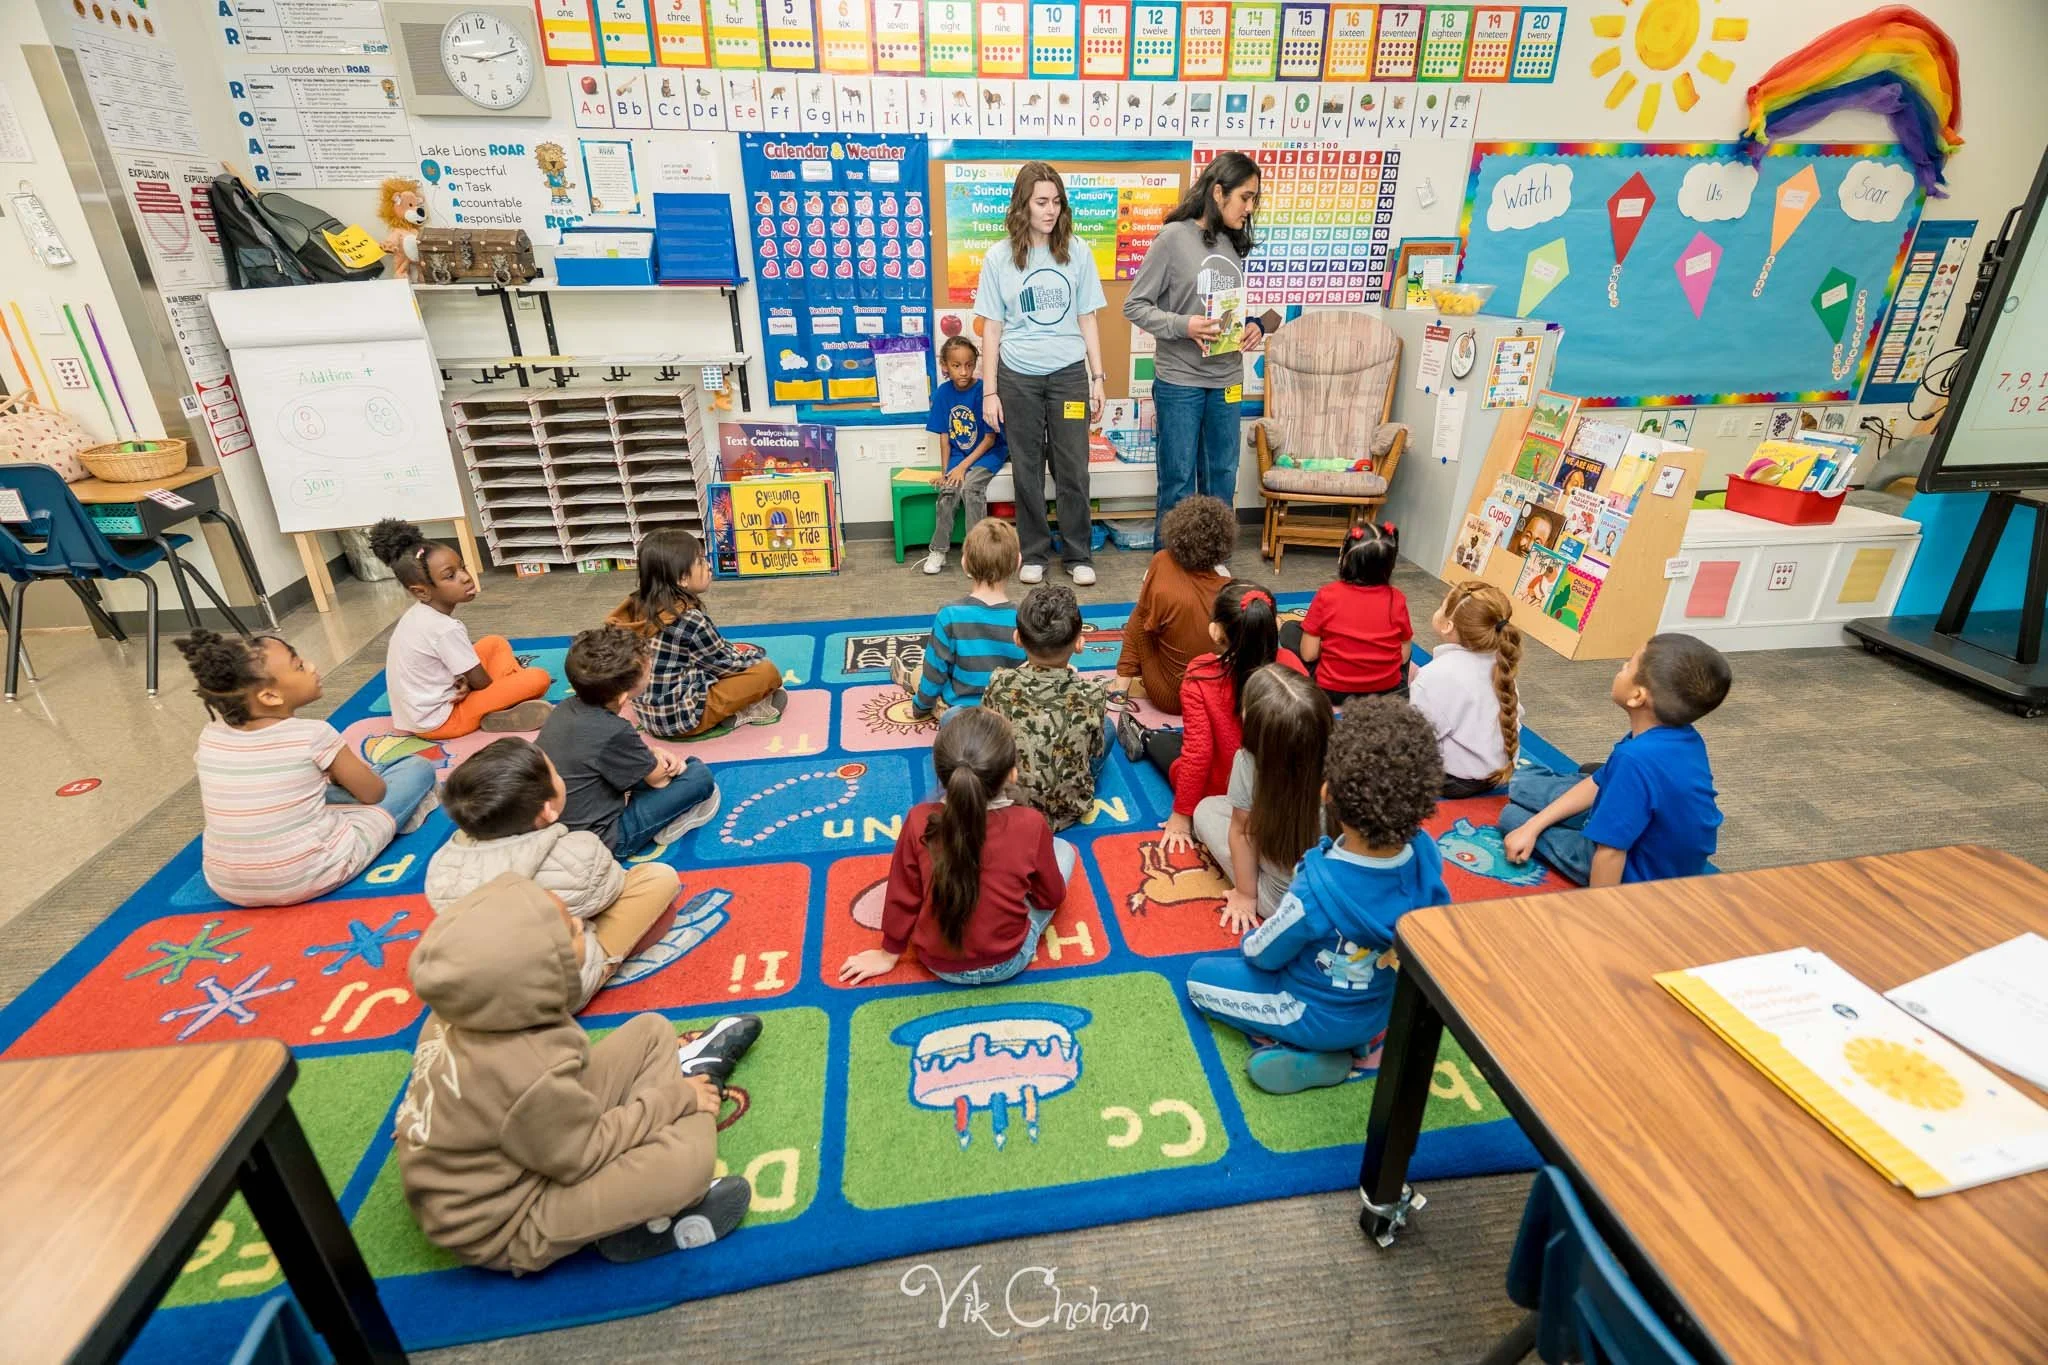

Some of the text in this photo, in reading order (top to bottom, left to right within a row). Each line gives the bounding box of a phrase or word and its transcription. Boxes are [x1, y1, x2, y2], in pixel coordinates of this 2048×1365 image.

[784, 0, 793, 14] 5
[894, 4, 902, 18] 7
[945, 5, 955, 20] 8
[556, 10, 574, 18] one
[613, 11, 632, 20] two
[666, 12, 691, 22] three
[996, 6, 1006, 21] 9
[1046, 6, 1062, 23] 10
[1098, 8, 1112, 24] 11
[1148, 8, 1164, 25] 12
[1198, 10, 1214, 26] 13
[1246, 10, 1264, 26] 14
[1297, 10, 1313, 26] 15
[474, 18, 486, 30] 12
[726, 14, 744, 25] four
[782, 15, 798, 26] five
[1344, 11, 1360, 28] 16
[1394, 12, 1408, 28] 17
[1440, 13, 1454, 28] 18
[1487, 14, 1501, 29] 19
[1532, 14, 1550, 30] 20
[460, 22, 470, 34] 11
[940, 20, 960, 34] eight
[994, 22, 1012, 33] nine
[1048, 23, 1061, 34] ten
[1092, 24, 1118, 34] eleven
[1142, 25, 1168, 36] twelve
[1189, 26, 1222, 36] thirteen
[1237, 26, 1271, 37] fourteen
[1290, 26, 1316, 38] fifteen
[225, 28, 240, 44] R
[1338, 28, 1364, 38] sixteen
[1381, 28, 1417, 39] seventeen
[1430, 28, 1462, 40] eighteen
[1476, 30, 1508, 40] nineteen
[1526, 30, 1552, 42] twenty
[450, 36, 461, 45] 10
[508, 36, 516, 48] 2
[452, 54, 459, 65] 9
[270, 65, 290, 74] Lion
[292, 65, 315, 74] code
[316, 65, 340, 74] when
[346, 65, 371, 74] ROAR
[460, 72, 468, 82] 8
[229, 81, 246, 98] R
[238, 111, 254, 127] O
[248, 138, 264, 154] A
[419, 144, 526, 156] Lake Lions ROAR
[764, 142, 906, 160] Calendar & Weather
[1262, 142, 1339, 150] NUMBERS 1-100
[1286, 152, 1293, 162] 5
[1386, 154, 1399, 163] 10
[128, 168, 170, 181] EXPULSION
[254, 165, 270, 182] R
[444, 165, 507, 178] Respectful
[771, 170, 796, 180] Month
[955, 166, 986, 180] Days
[1323, 168, 1337, 178] 17
[1383, 169, 1398, 179] 20
[1070, 175, 1116, 187] Months
[1140, 176, 1166, 187] Year
[448, 182, 492, 192] On Task
[974, 185, 1014, 198] Sunday
[1504, 172, 1552, 209] Watch
[1705, 183, 1723, 202] Us
[1854, 175, 1890, 204] Soar
[1074, 190, 1114, 202] January
[1133, 192, 1151, 201] July
[452, 198, 522, 208] Accountable
[972, 203, 1008, 214] Mond
[1378, 198, 1392, 208] 40
[1074, 206, 1116, 218] February
[1132, 206, 1162, 217] August
[456, 214, 522, 225] Responsible
[1074, 222, 1104, 232] March
[1132, 223, 1163, 232] Septem
[1374, 230, 1387, 238] 60
[1250, 260, 1264, 270] 74
[1312, 261, 1326, 271] 77
[1212, 273, 1235, 282] LEADERS
[1330, 277, 1343, 286] 88
[1034, 288, 1063, 298] LEADERS
[1267, 292, 1282, 302] 95
[1366, 292, 1380, 301] 100
[1034, 296, 1063, 304] READERS
[770, 308, 792, 316] Today
[809, 306, 843, 316] Yesterday
[853, 306, 888, 314] Tomorrow
[901, 306, 926, 314] Season
[1036, 302, 1067, 312] NETWORK
[299, 368, 352, 385] Addition
[726, 436, 800, 448] Text Collection
[1565, 456, 1602, 474] WE ARE HERE
[755, 489, 800, 508] Everyone
[795, 507, 820, 526] learn
[1488, 505, 1513, 528] Cupig
[750, 531, 764, 546] to
[798, 528, 820, 544] ride
[750, 551, 758, 566] a
[762, 551, 798, 570] bicycle
